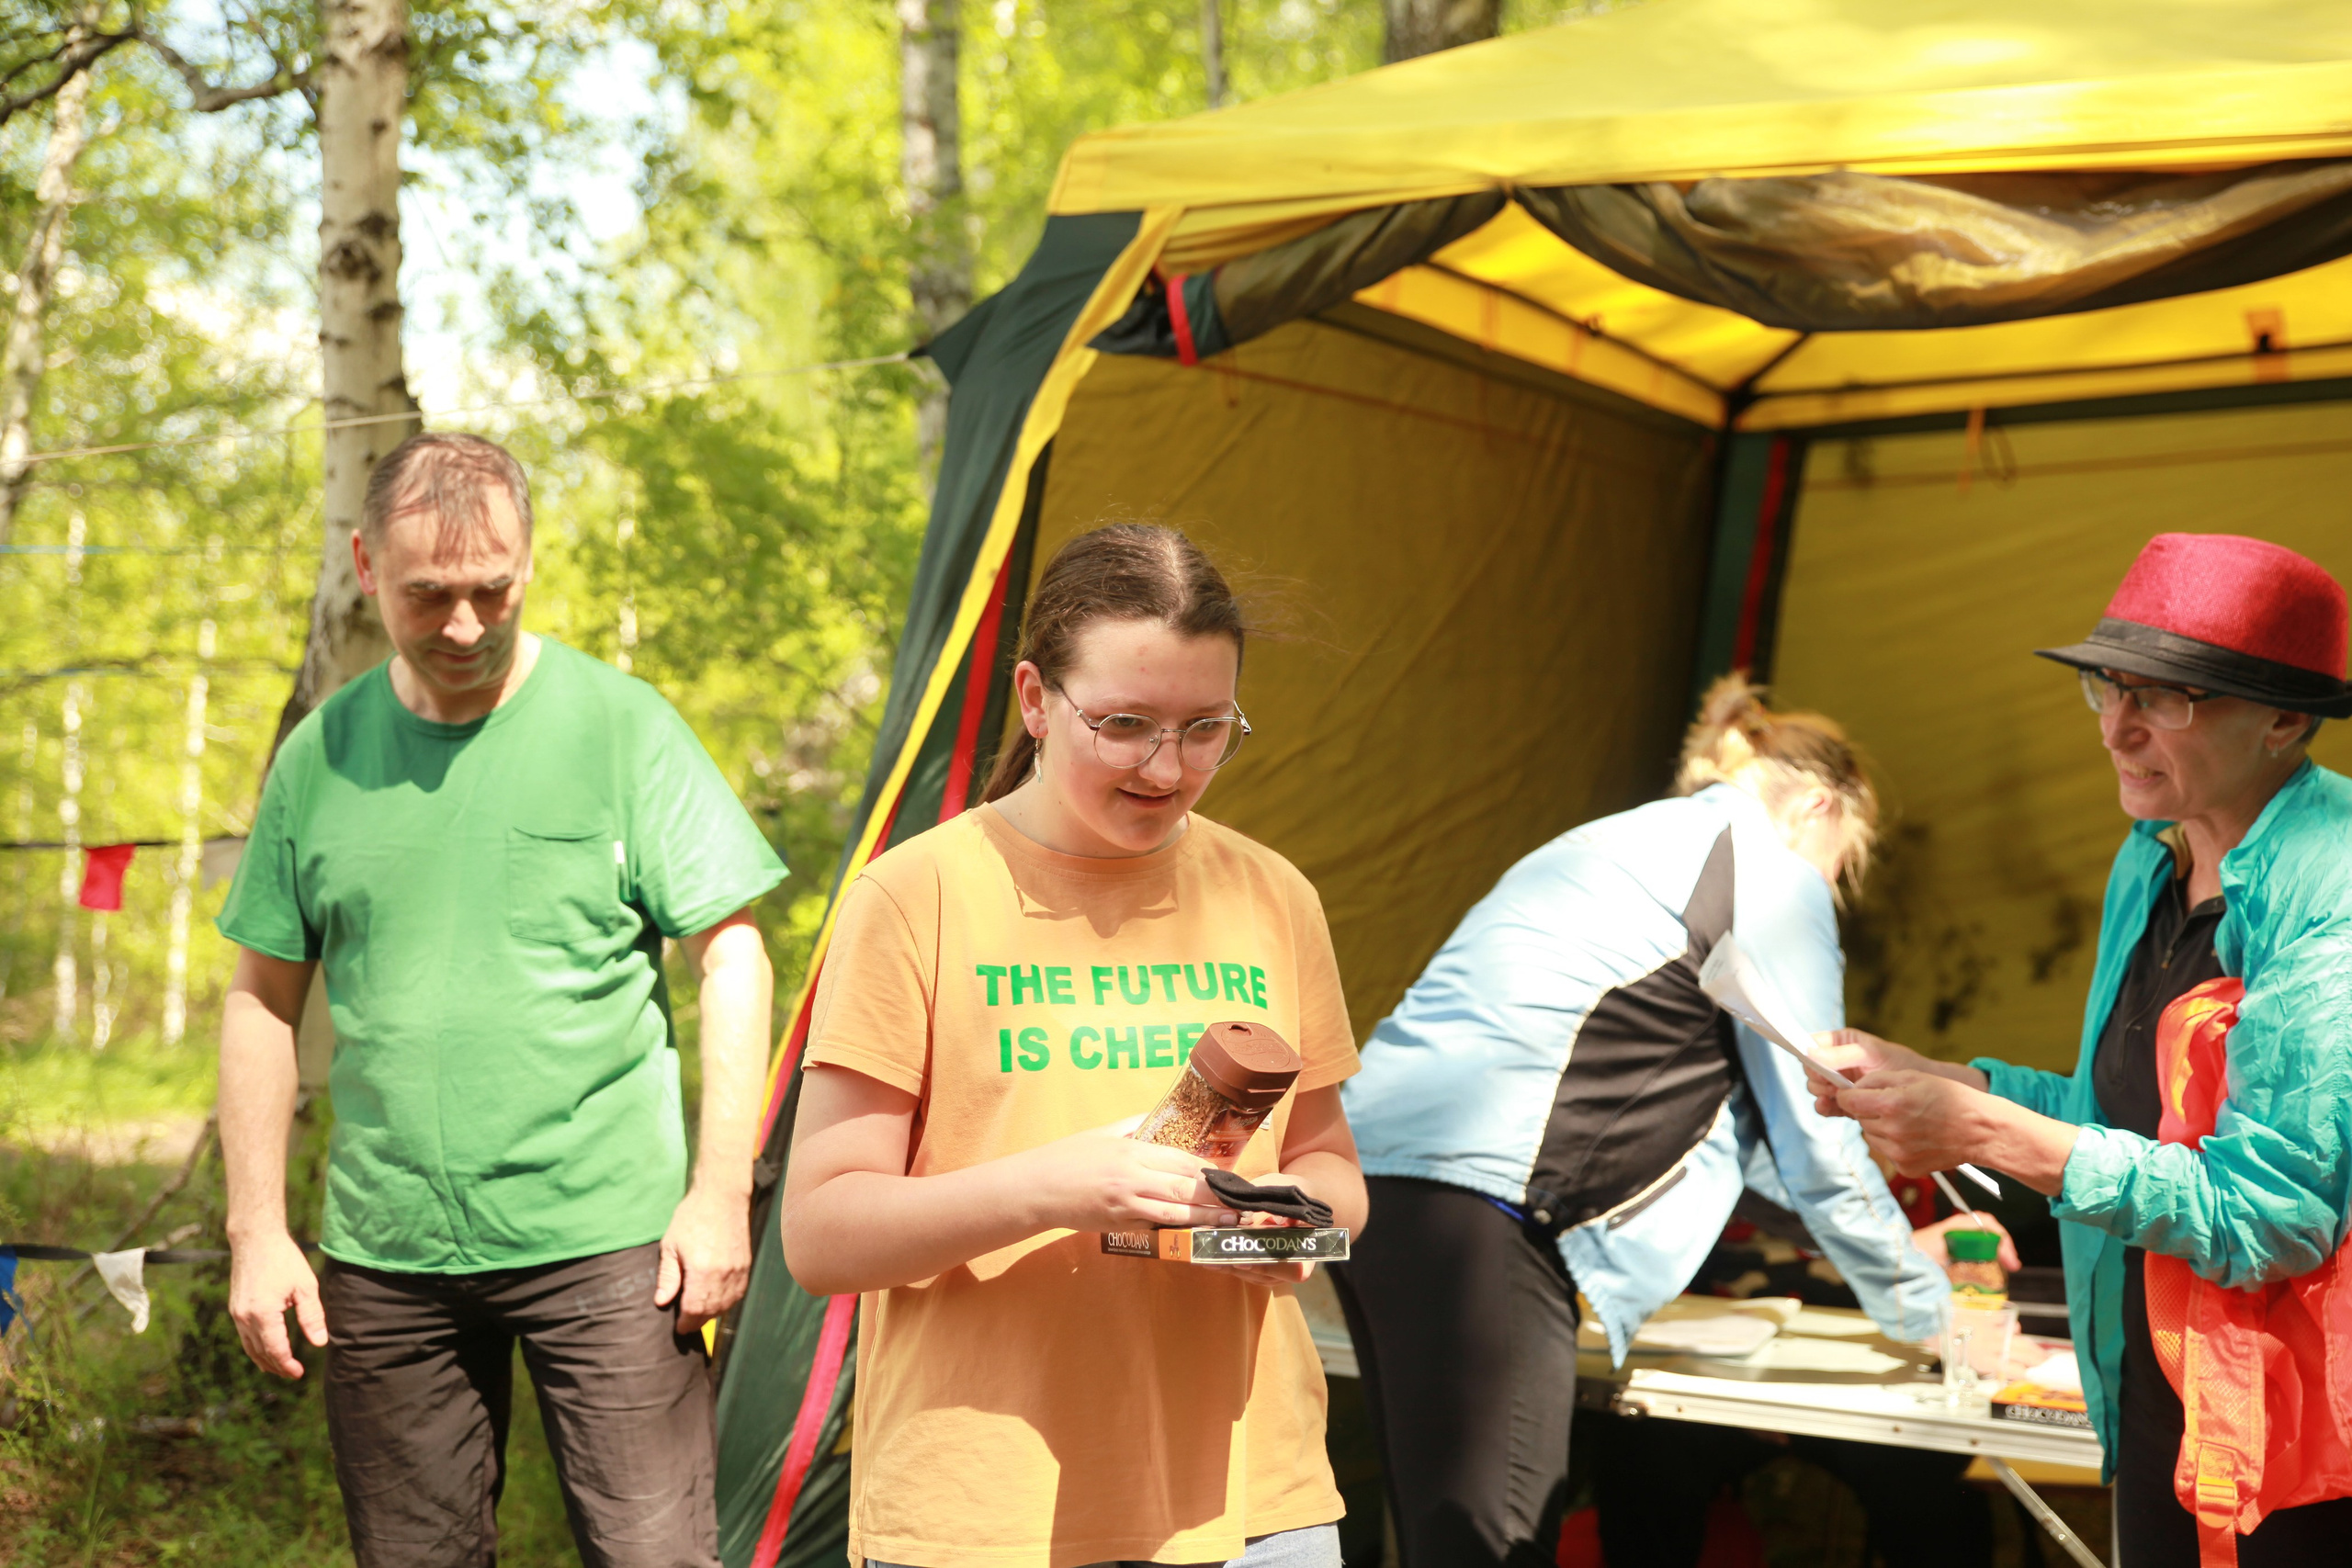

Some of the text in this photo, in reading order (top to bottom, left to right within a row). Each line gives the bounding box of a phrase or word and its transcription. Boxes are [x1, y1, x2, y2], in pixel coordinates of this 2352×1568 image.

[976, 962, 1268, 1010] THE FUTURE
[999, 1022, 1205, 1073] IS CHEE
